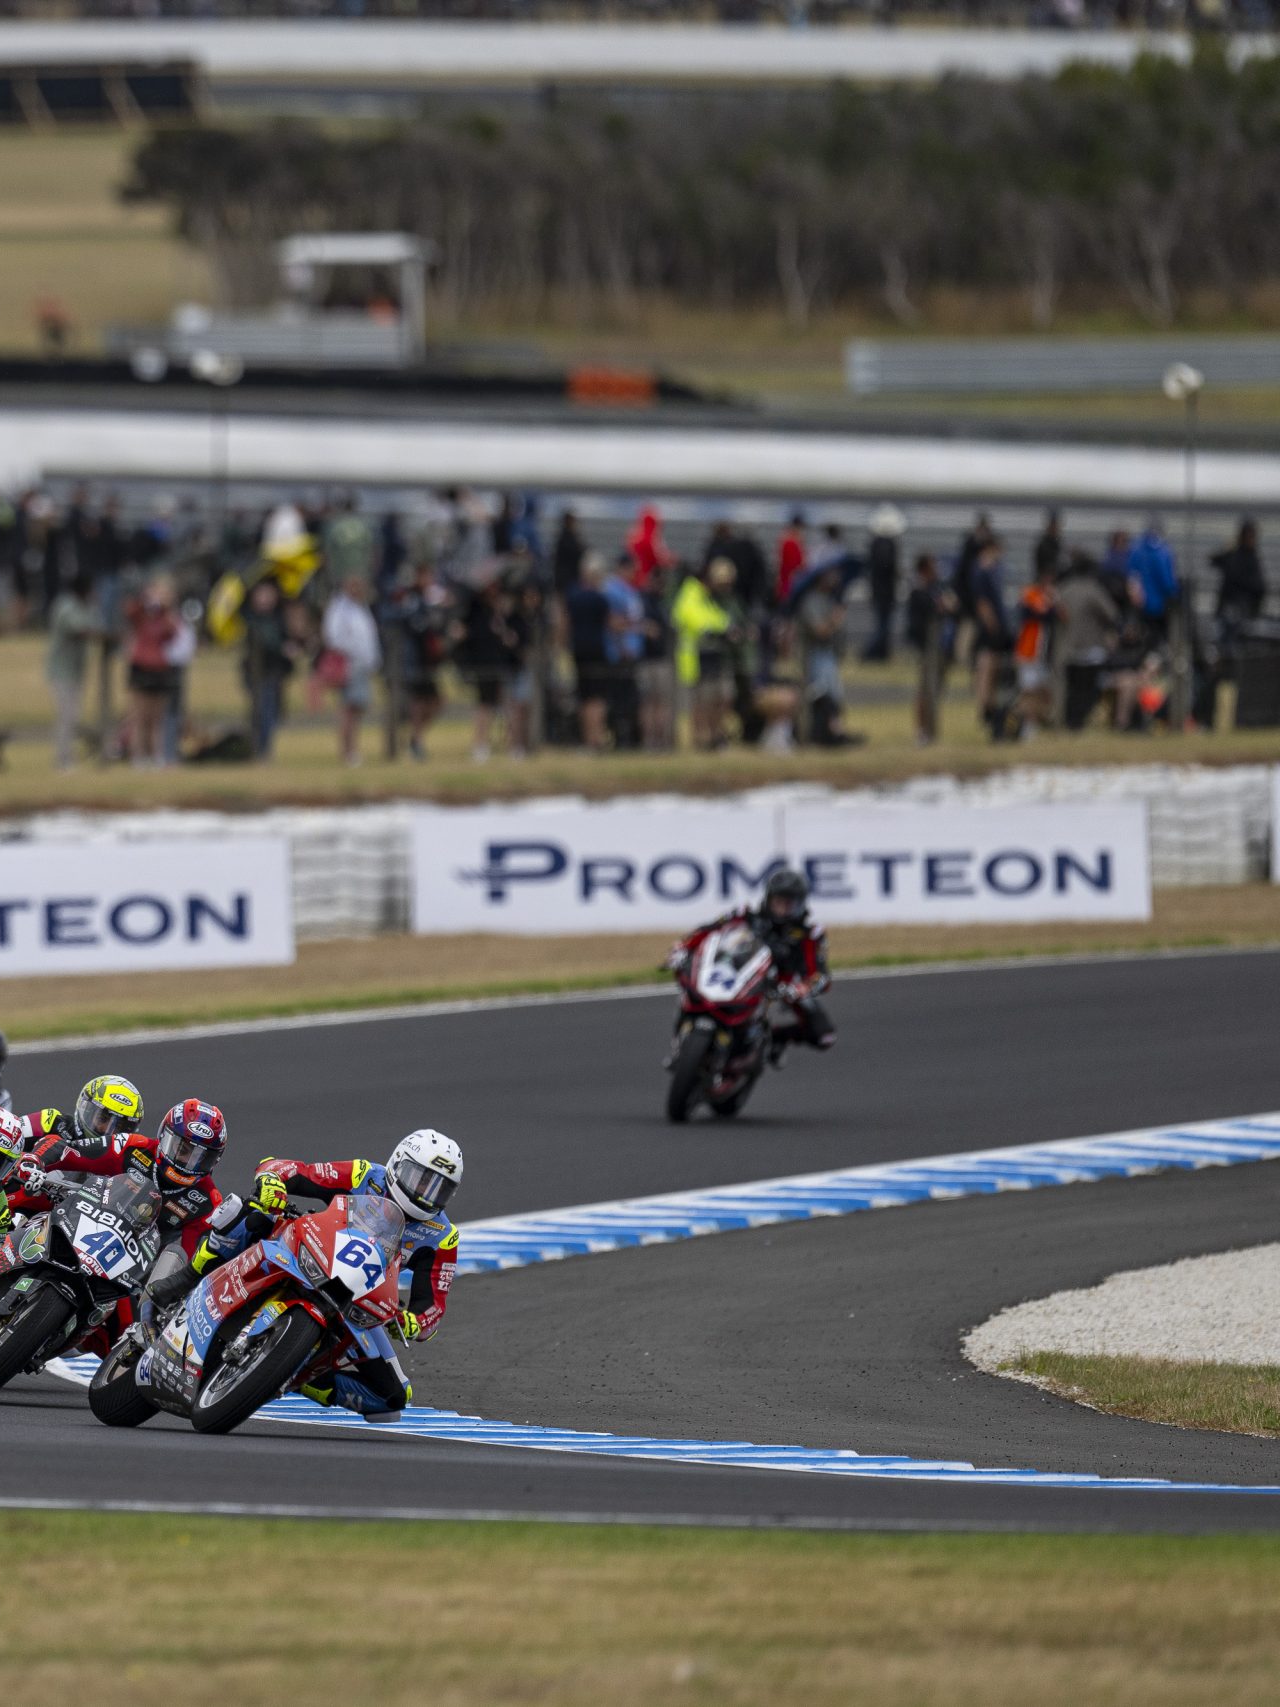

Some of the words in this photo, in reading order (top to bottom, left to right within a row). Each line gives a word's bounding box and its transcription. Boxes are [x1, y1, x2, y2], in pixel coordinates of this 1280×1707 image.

[484, 840, 1112, 904] PROMETEON
[193, 1123, 211, 1136] Arai
[76, 1200, 149, 1272] BIBLION
[80, 1230, 127, 1273] 40
[78, 1252, 104, 1277] MOTUL
[336, 1239, 383, 1291] 64
